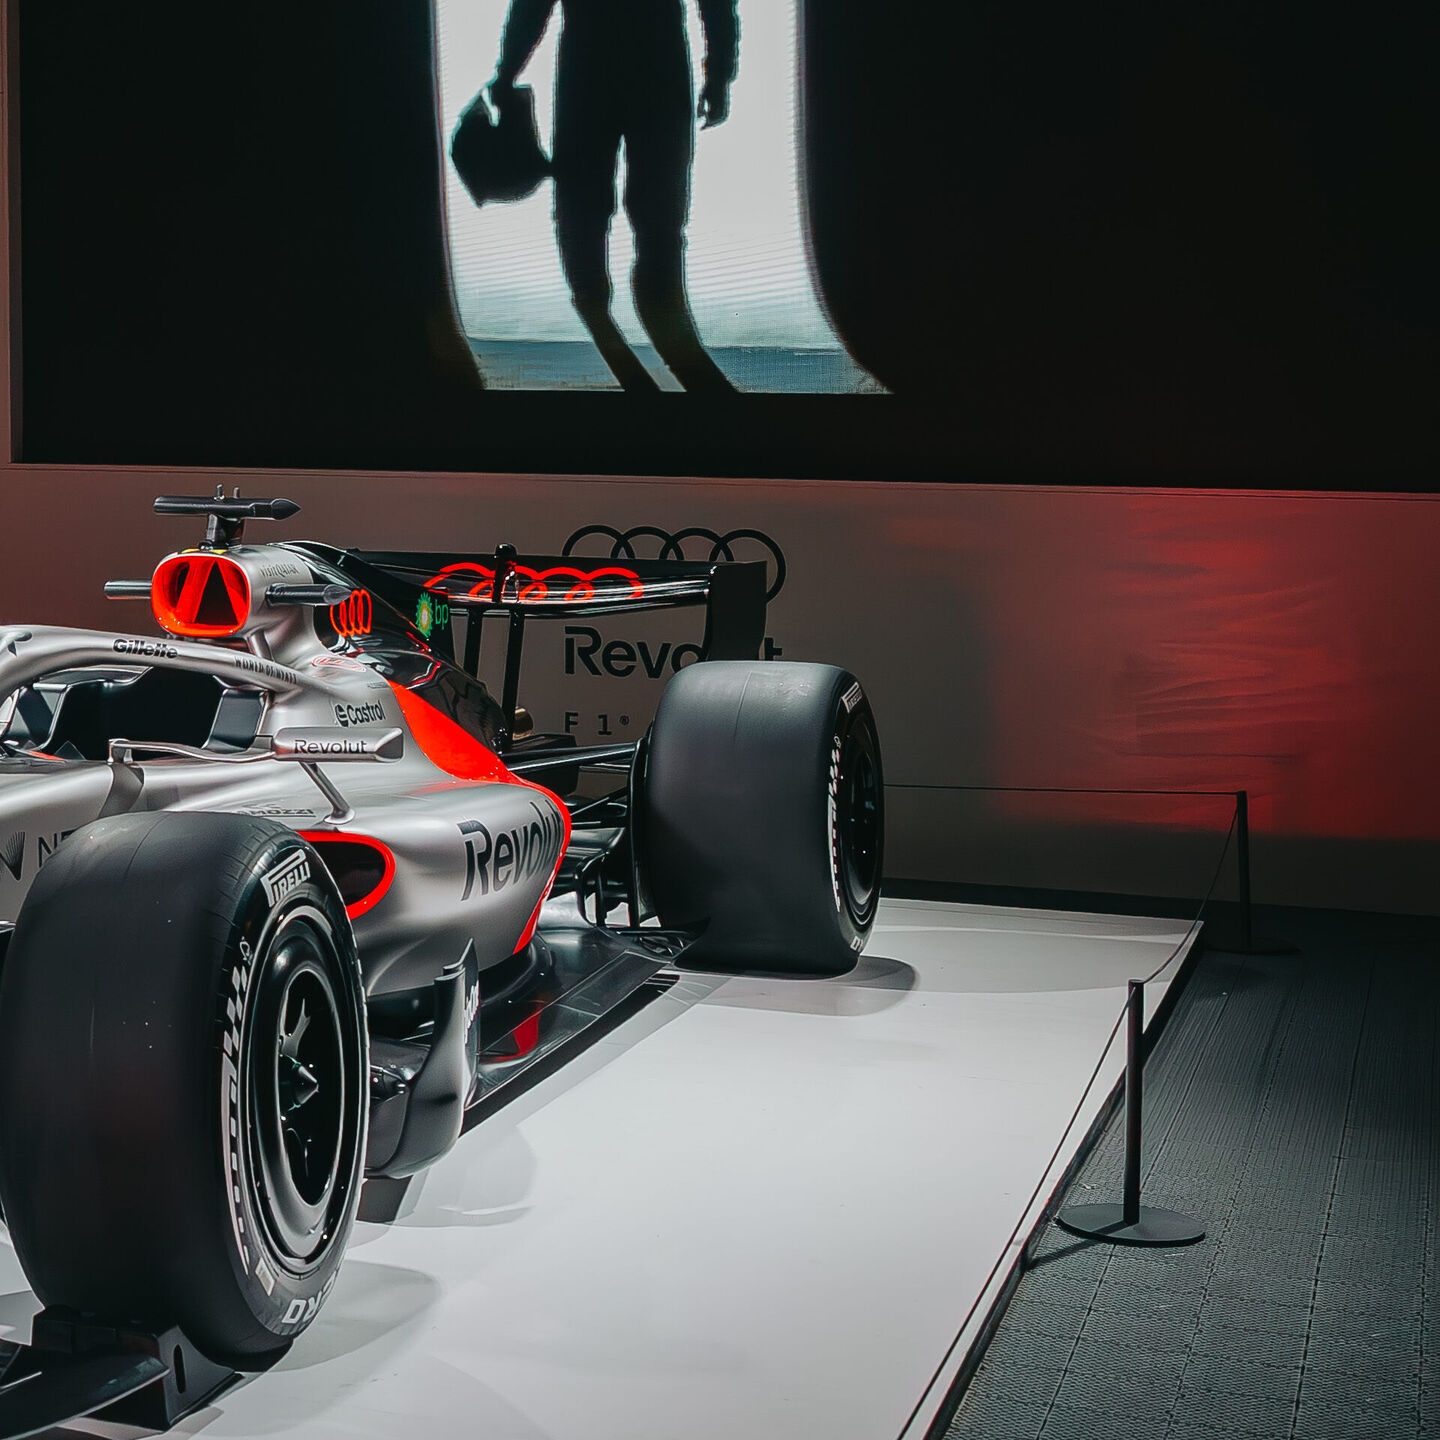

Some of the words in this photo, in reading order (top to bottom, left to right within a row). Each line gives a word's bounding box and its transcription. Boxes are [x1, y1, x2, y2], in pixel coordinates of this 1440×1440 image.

[435, 598, 449, 630] bp
[112, 638, 179, 659] Gillette
[564, 625, 783, 679] Revot
[347, 700, 385, 725] Castrol
[293, 738, 368, 755] Revolut
[260, 848, 311, 908] PIRELLI
